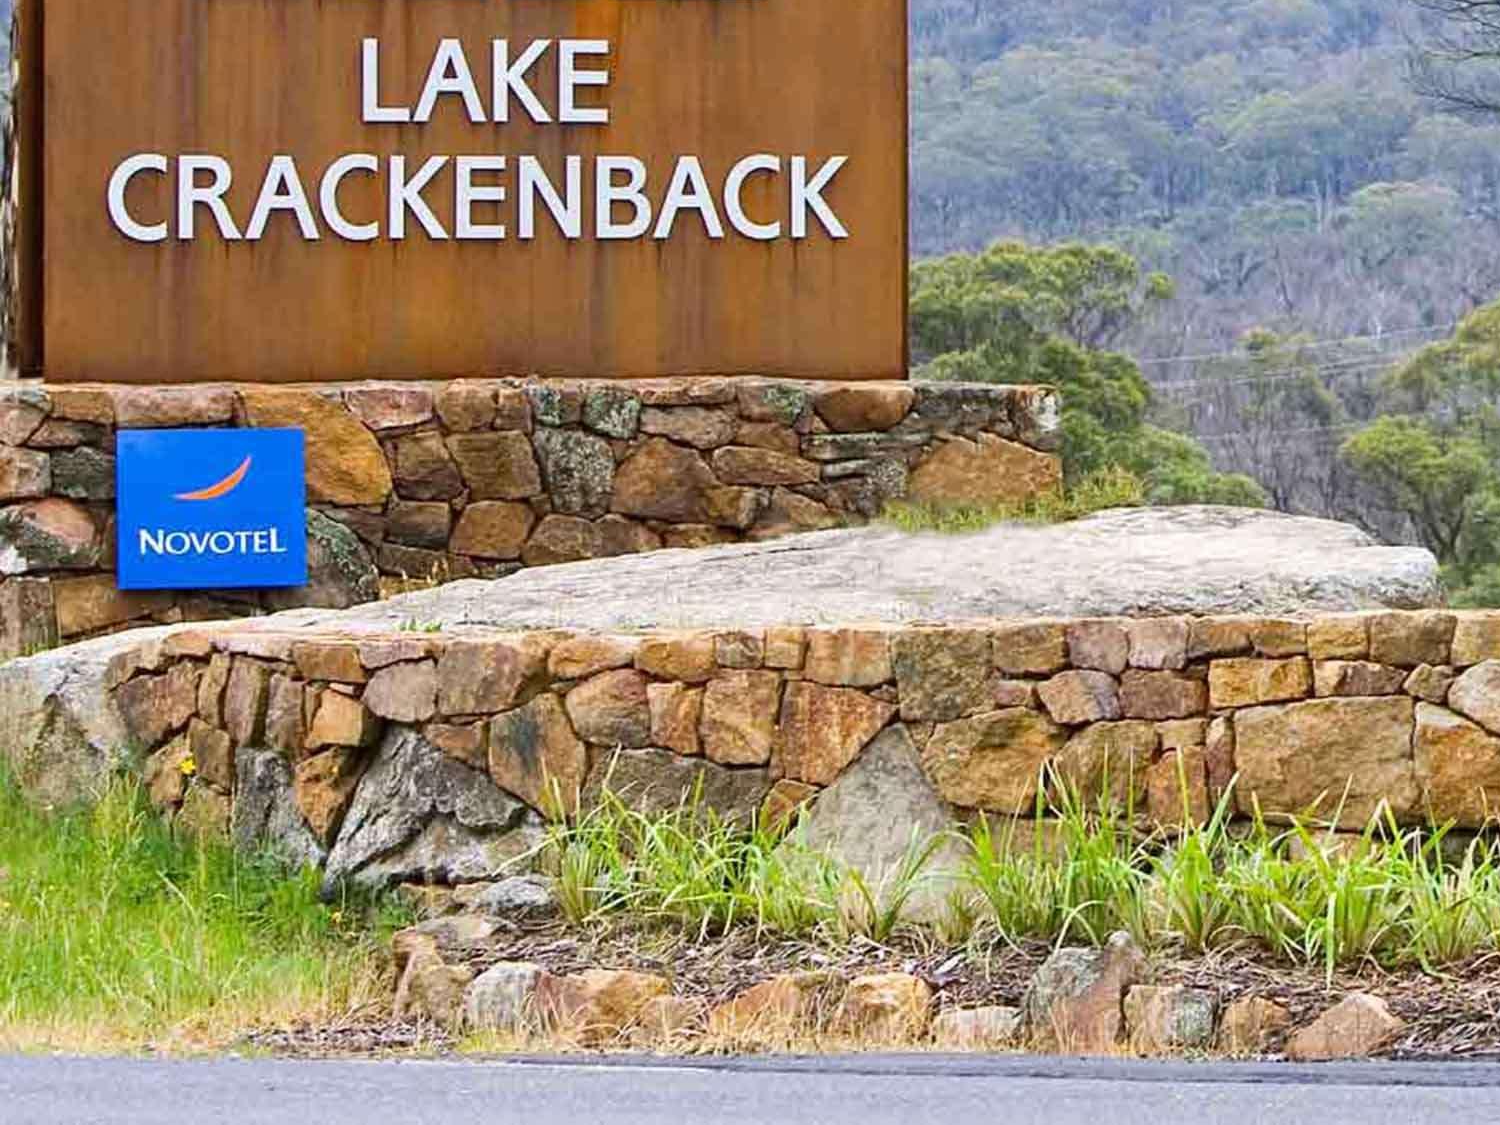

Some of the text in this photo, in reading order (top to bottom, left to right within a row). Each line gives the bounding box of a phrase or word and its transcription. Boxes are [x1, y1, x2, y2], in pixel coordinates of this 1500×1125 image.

[361, 38, 610, 123] LAKE
[107, 153, 849, 242] CRACKENBACK
[139, 528, 287, 555] NOVOTEL
